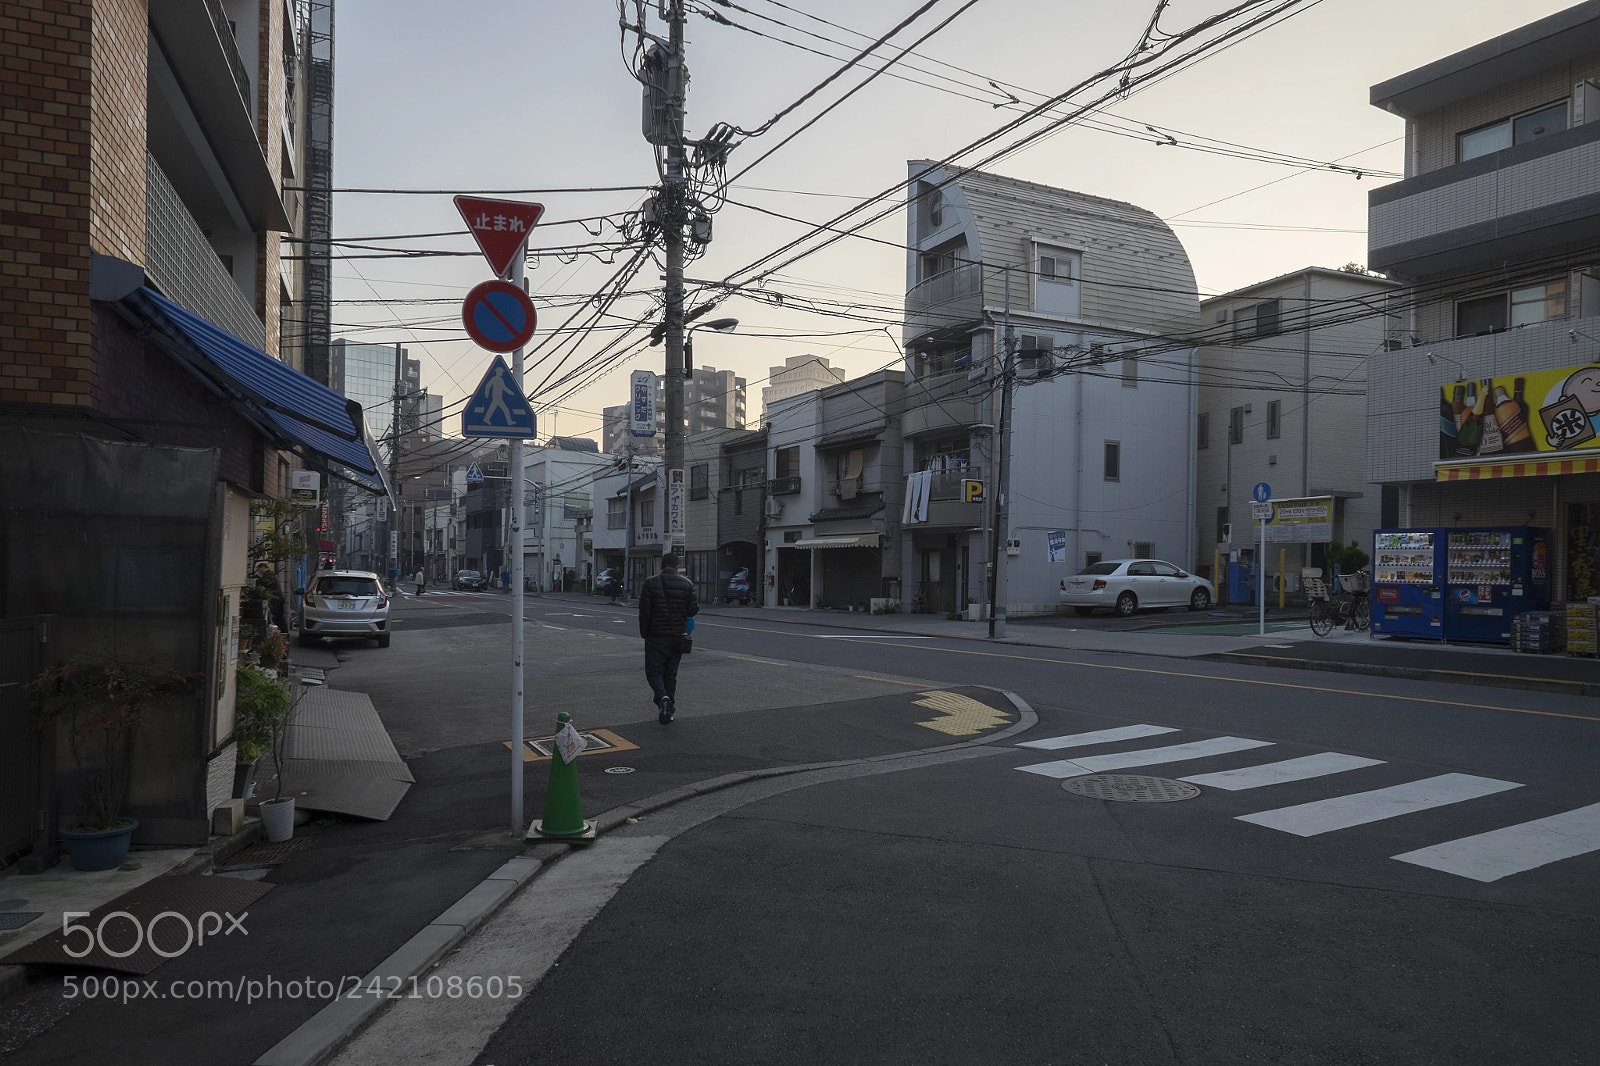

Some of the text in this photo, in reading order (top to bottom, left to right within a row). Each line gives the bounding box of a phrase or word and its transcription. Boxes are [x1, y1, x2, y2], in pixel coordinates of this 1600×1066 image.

[474, 212, 526, 233] 止まれ
[1553, 409, 1584, 437] 米
[672, 470, 684, 483] 質
[966, 481, 983, 502] P
[671, 488, 679, 519] アイカワ
